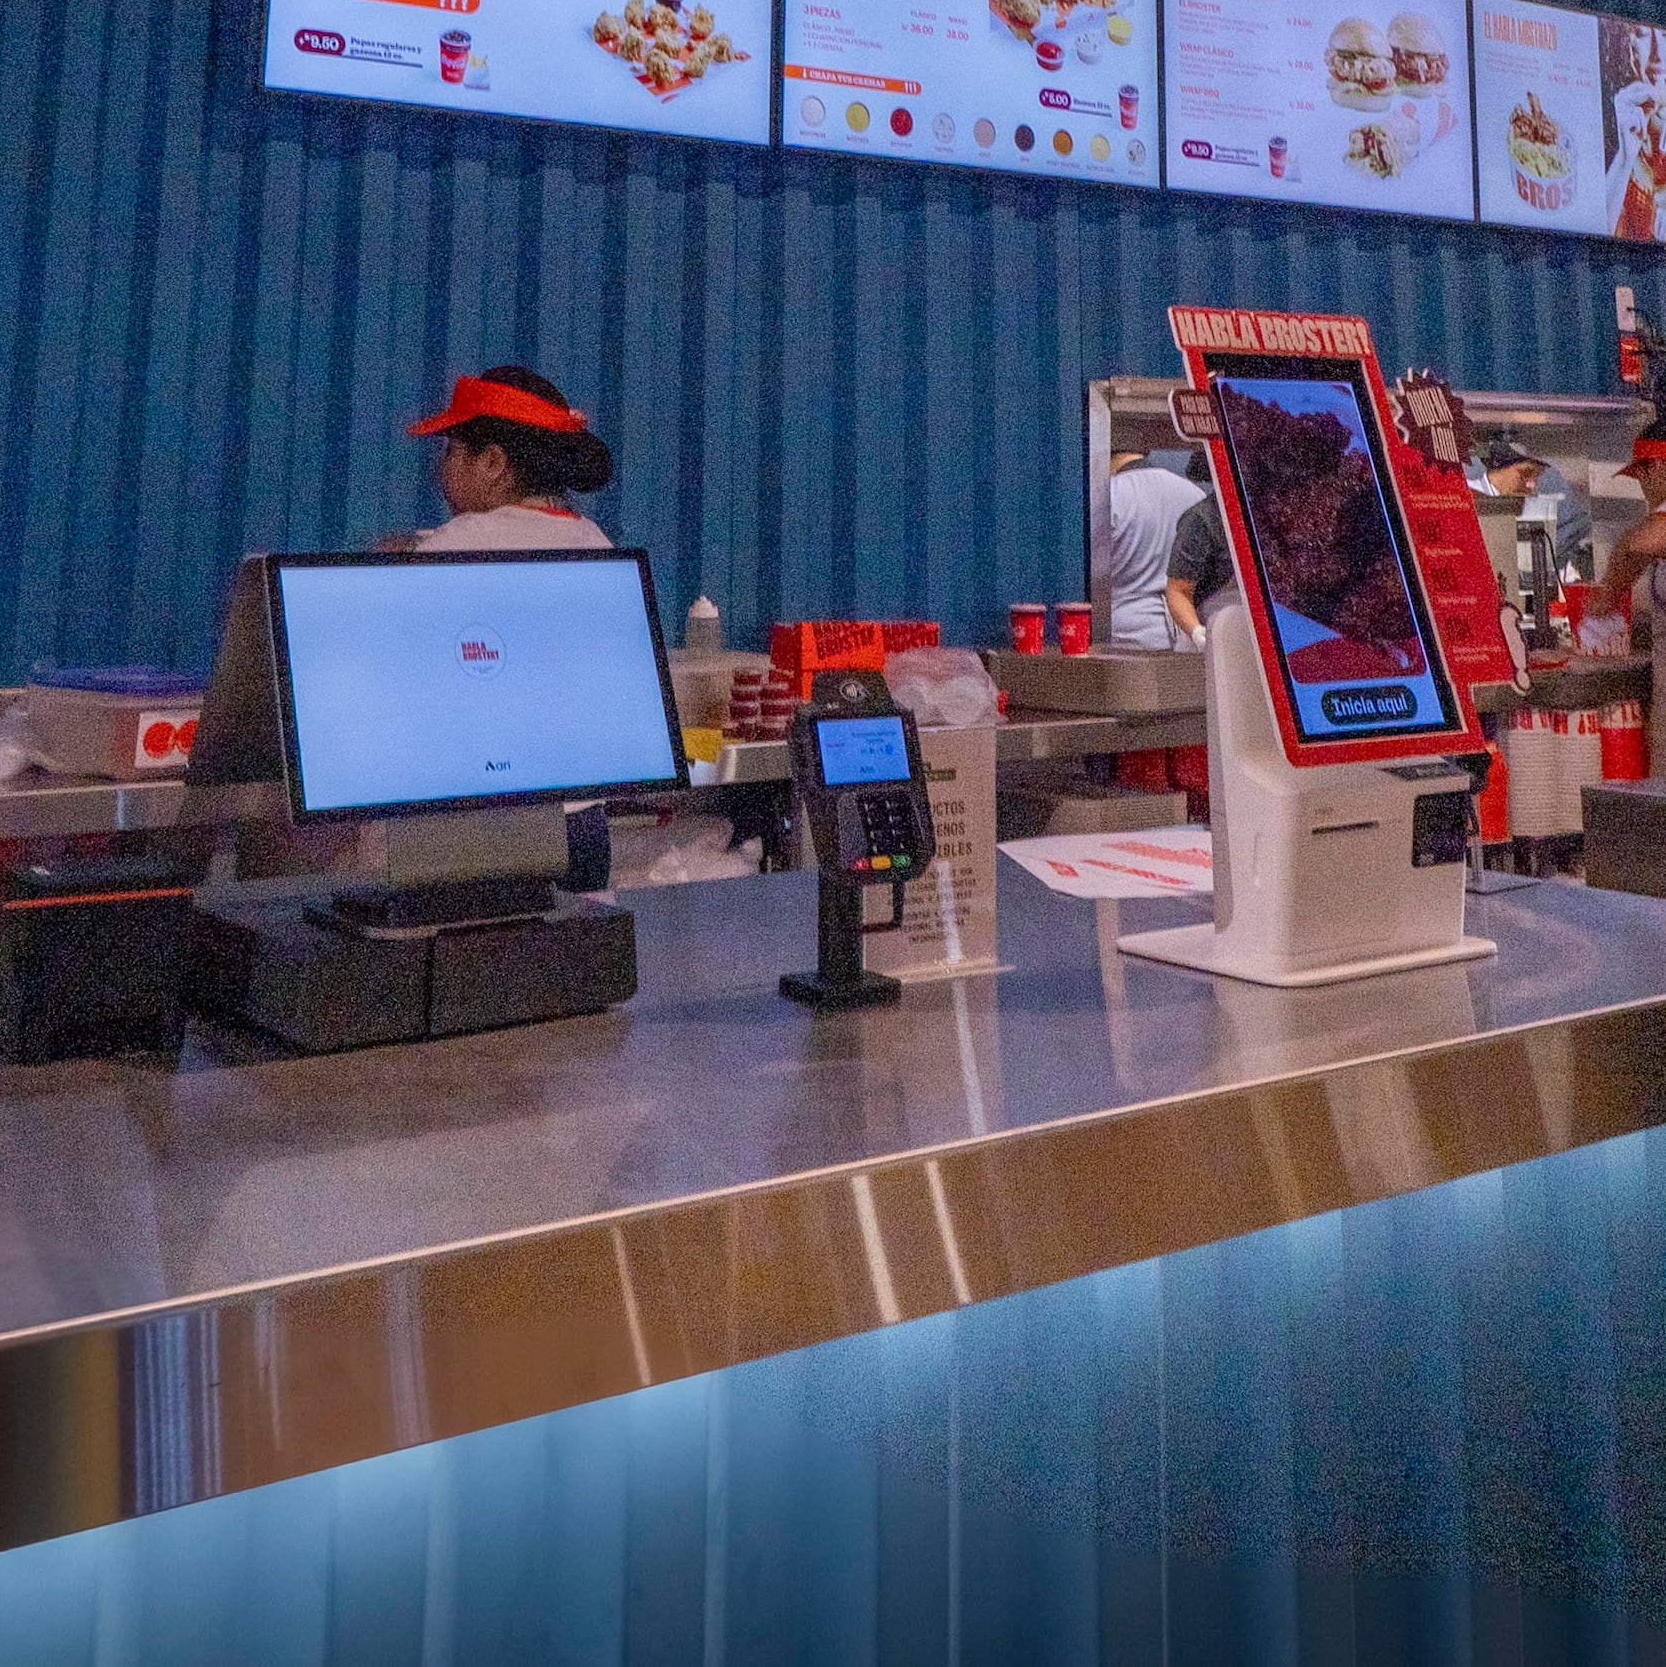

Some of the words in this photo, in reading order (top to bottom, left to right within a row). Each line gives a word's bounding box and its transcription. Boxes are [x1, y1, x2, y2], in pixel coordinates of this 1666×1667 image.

[1176, 312, 1260, 351] HABLA
[1256, 315, 1371, 355] BROSTER!
[1331, 696, 1375, 718] Inicia
